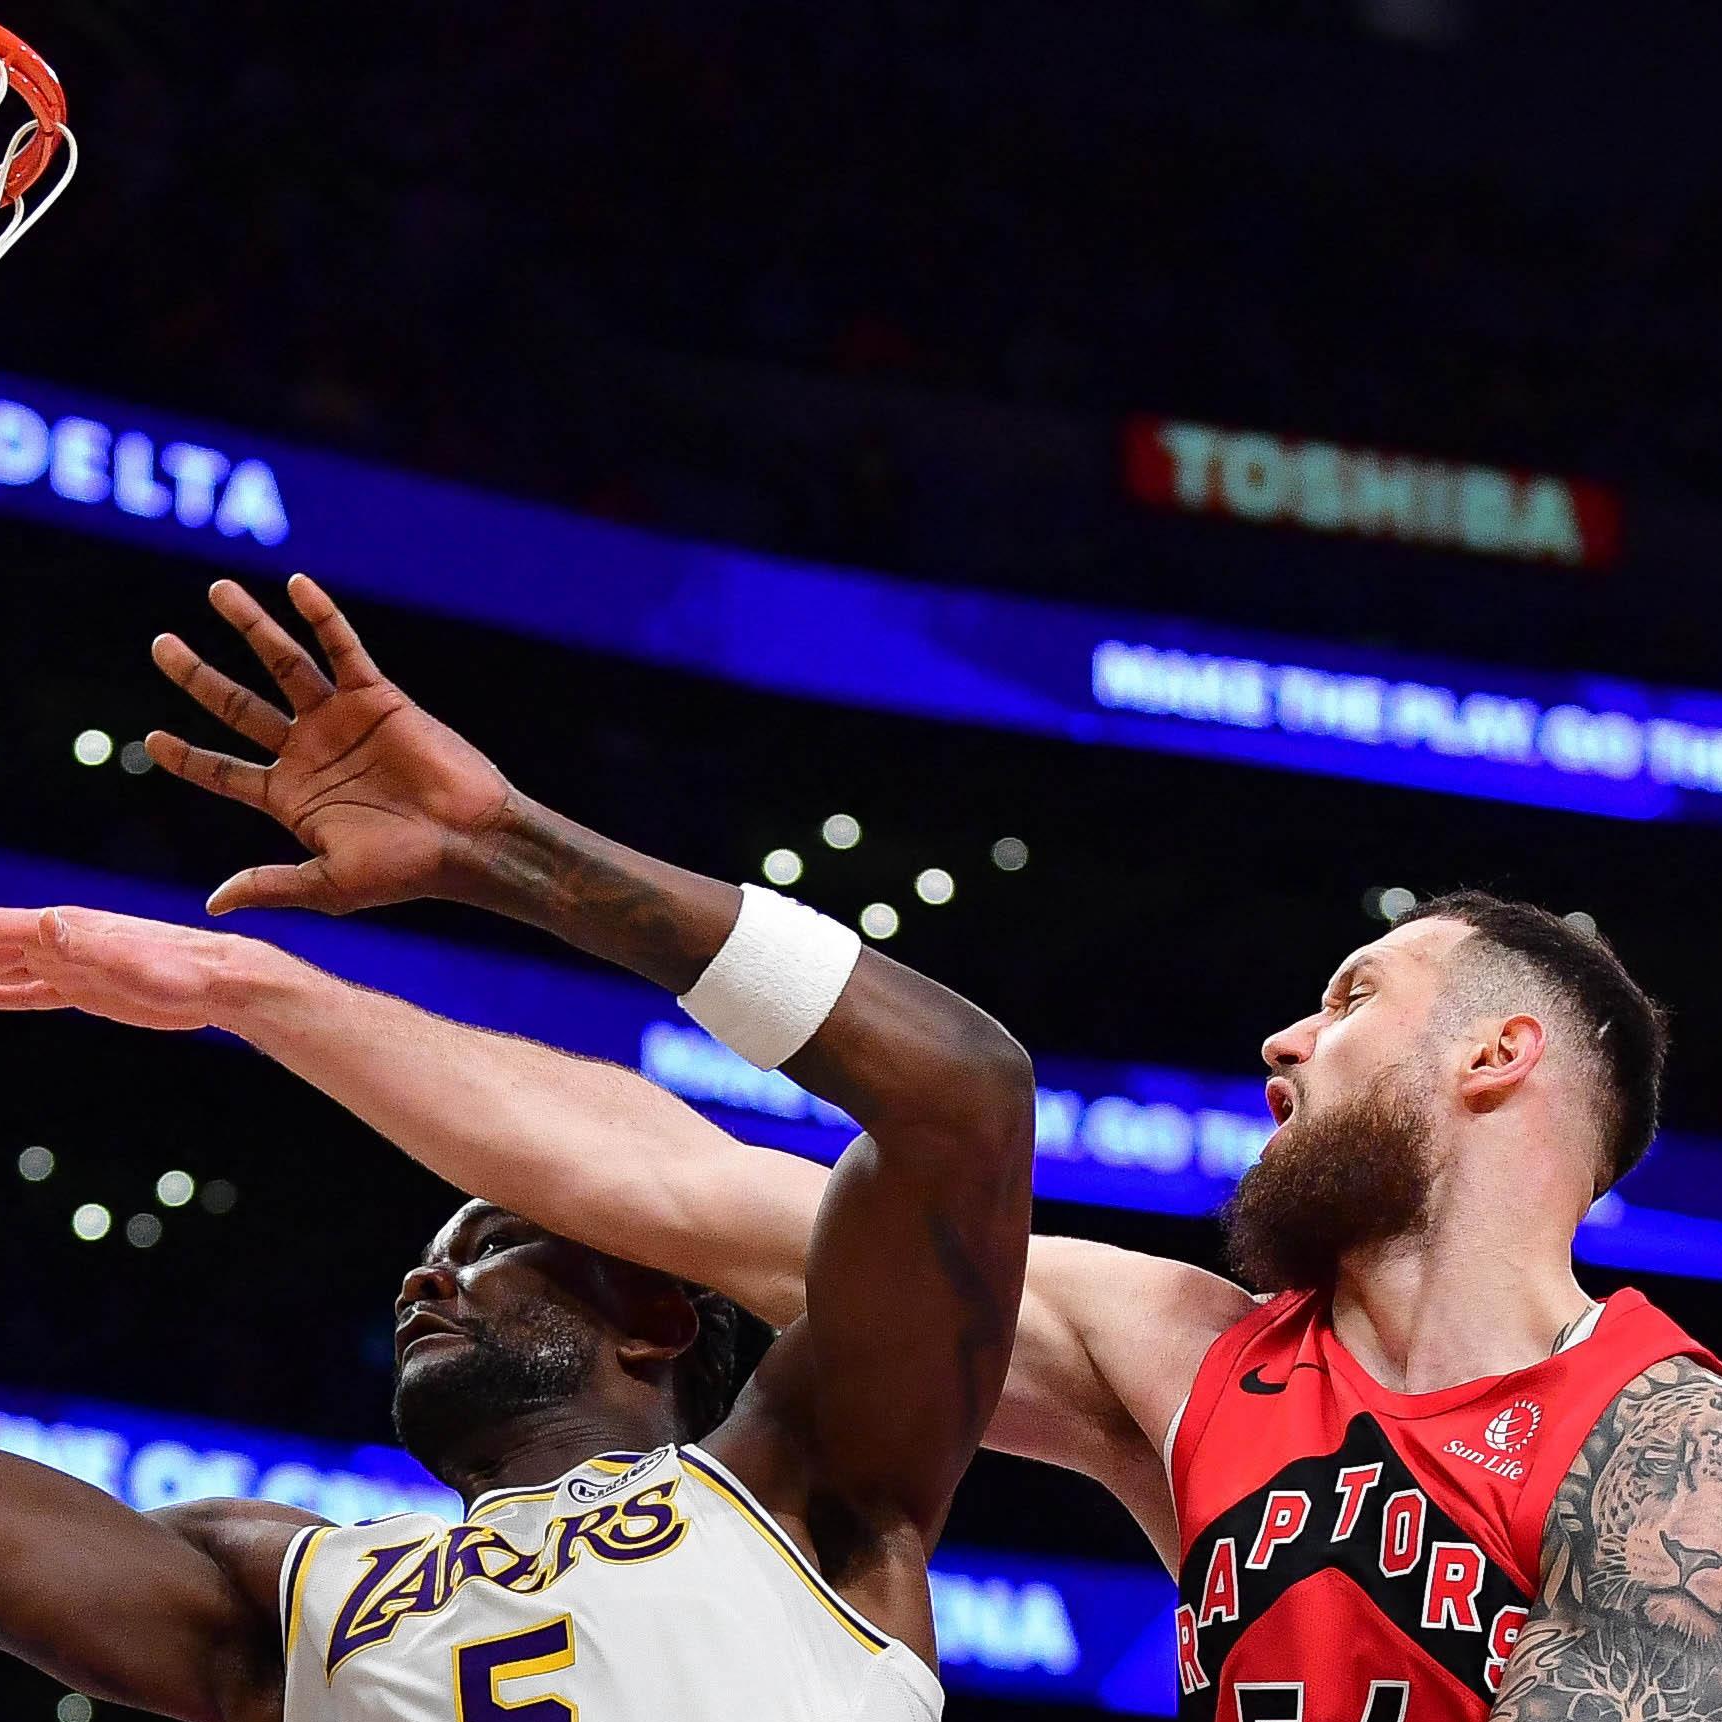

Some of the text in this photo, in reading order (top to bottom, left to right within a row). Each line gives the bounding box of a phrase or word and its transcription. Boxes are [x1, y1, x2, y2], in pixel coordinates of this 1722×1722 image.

[1158, 418, 1582, 566] TOSHIBA
[1092, 640, 1272, 729] MAKE
[1443, 1439, 1524, 1480] Sun Life
[1175, 1462, 1529, 1694] RAPTORS
